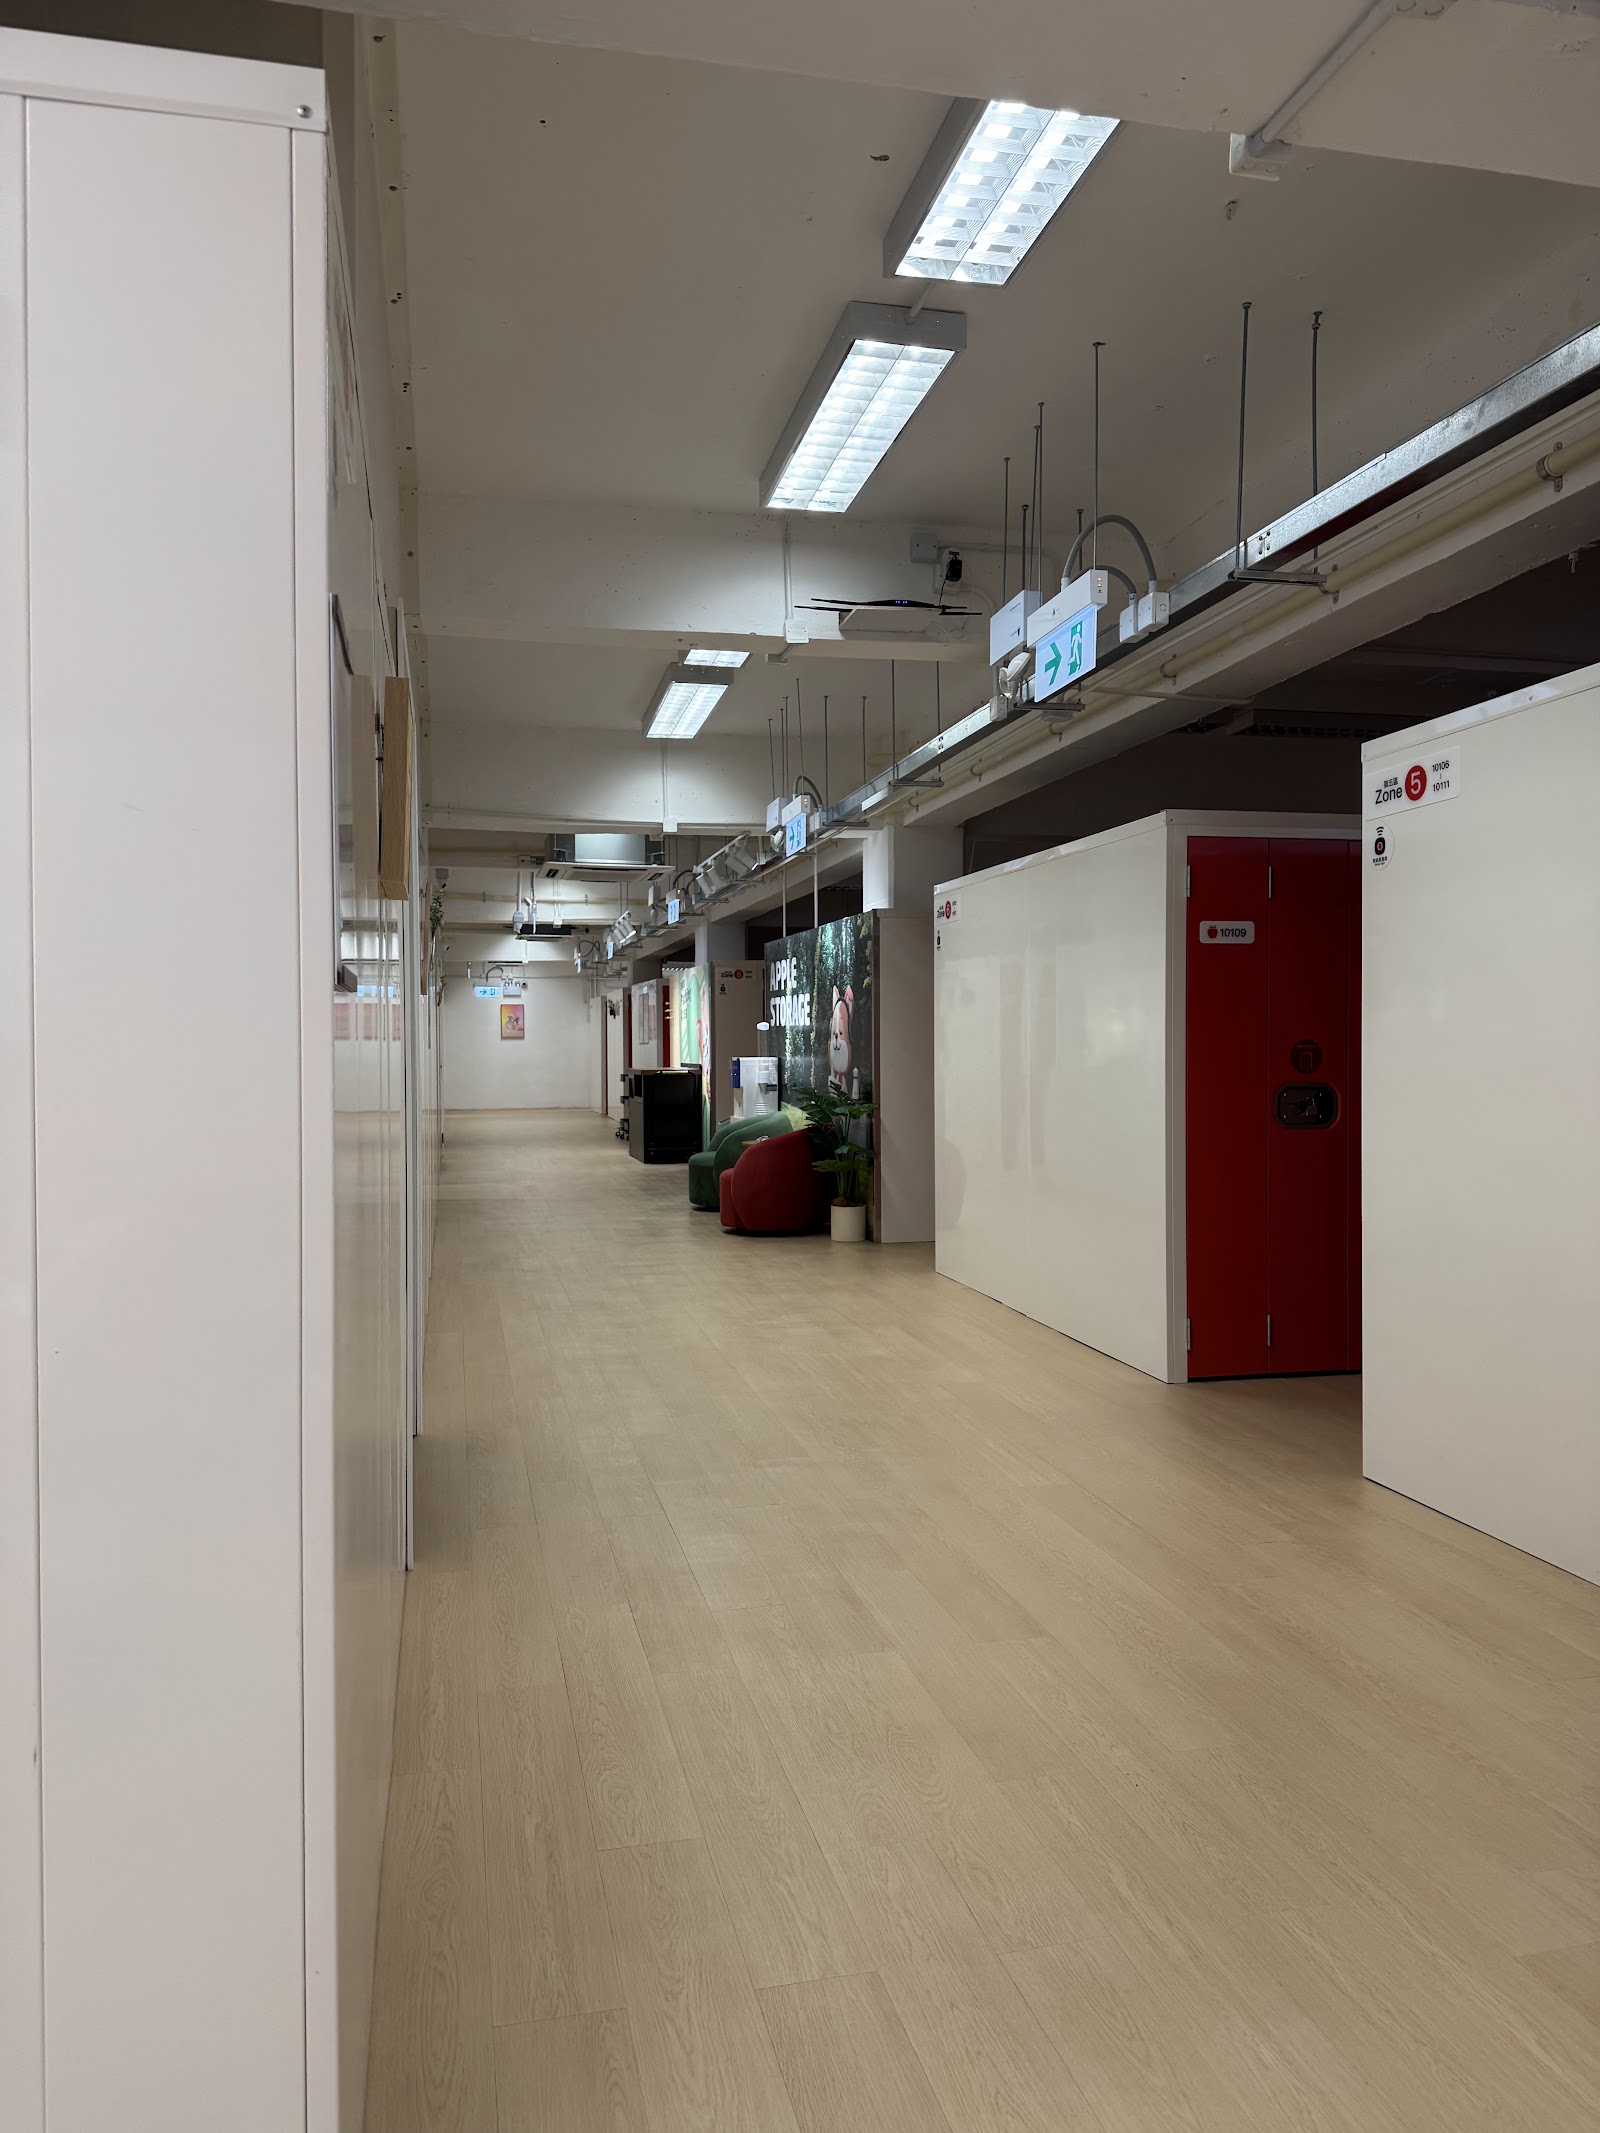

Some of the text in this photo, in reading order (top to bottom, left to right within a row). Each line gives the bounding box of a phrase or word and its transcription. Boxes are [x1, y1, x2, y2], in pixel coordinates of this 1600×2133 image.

[1432, 760, 1450, 772] 10106
[1375, 771, 1422, 804] Zone 5
[1432, 780, 1450, 792] 10111
[1220, 928, 1246, 937] 10109
[769, 956, 797, 992] APPLE
[769, 992, 811, 1027] STORAGE
